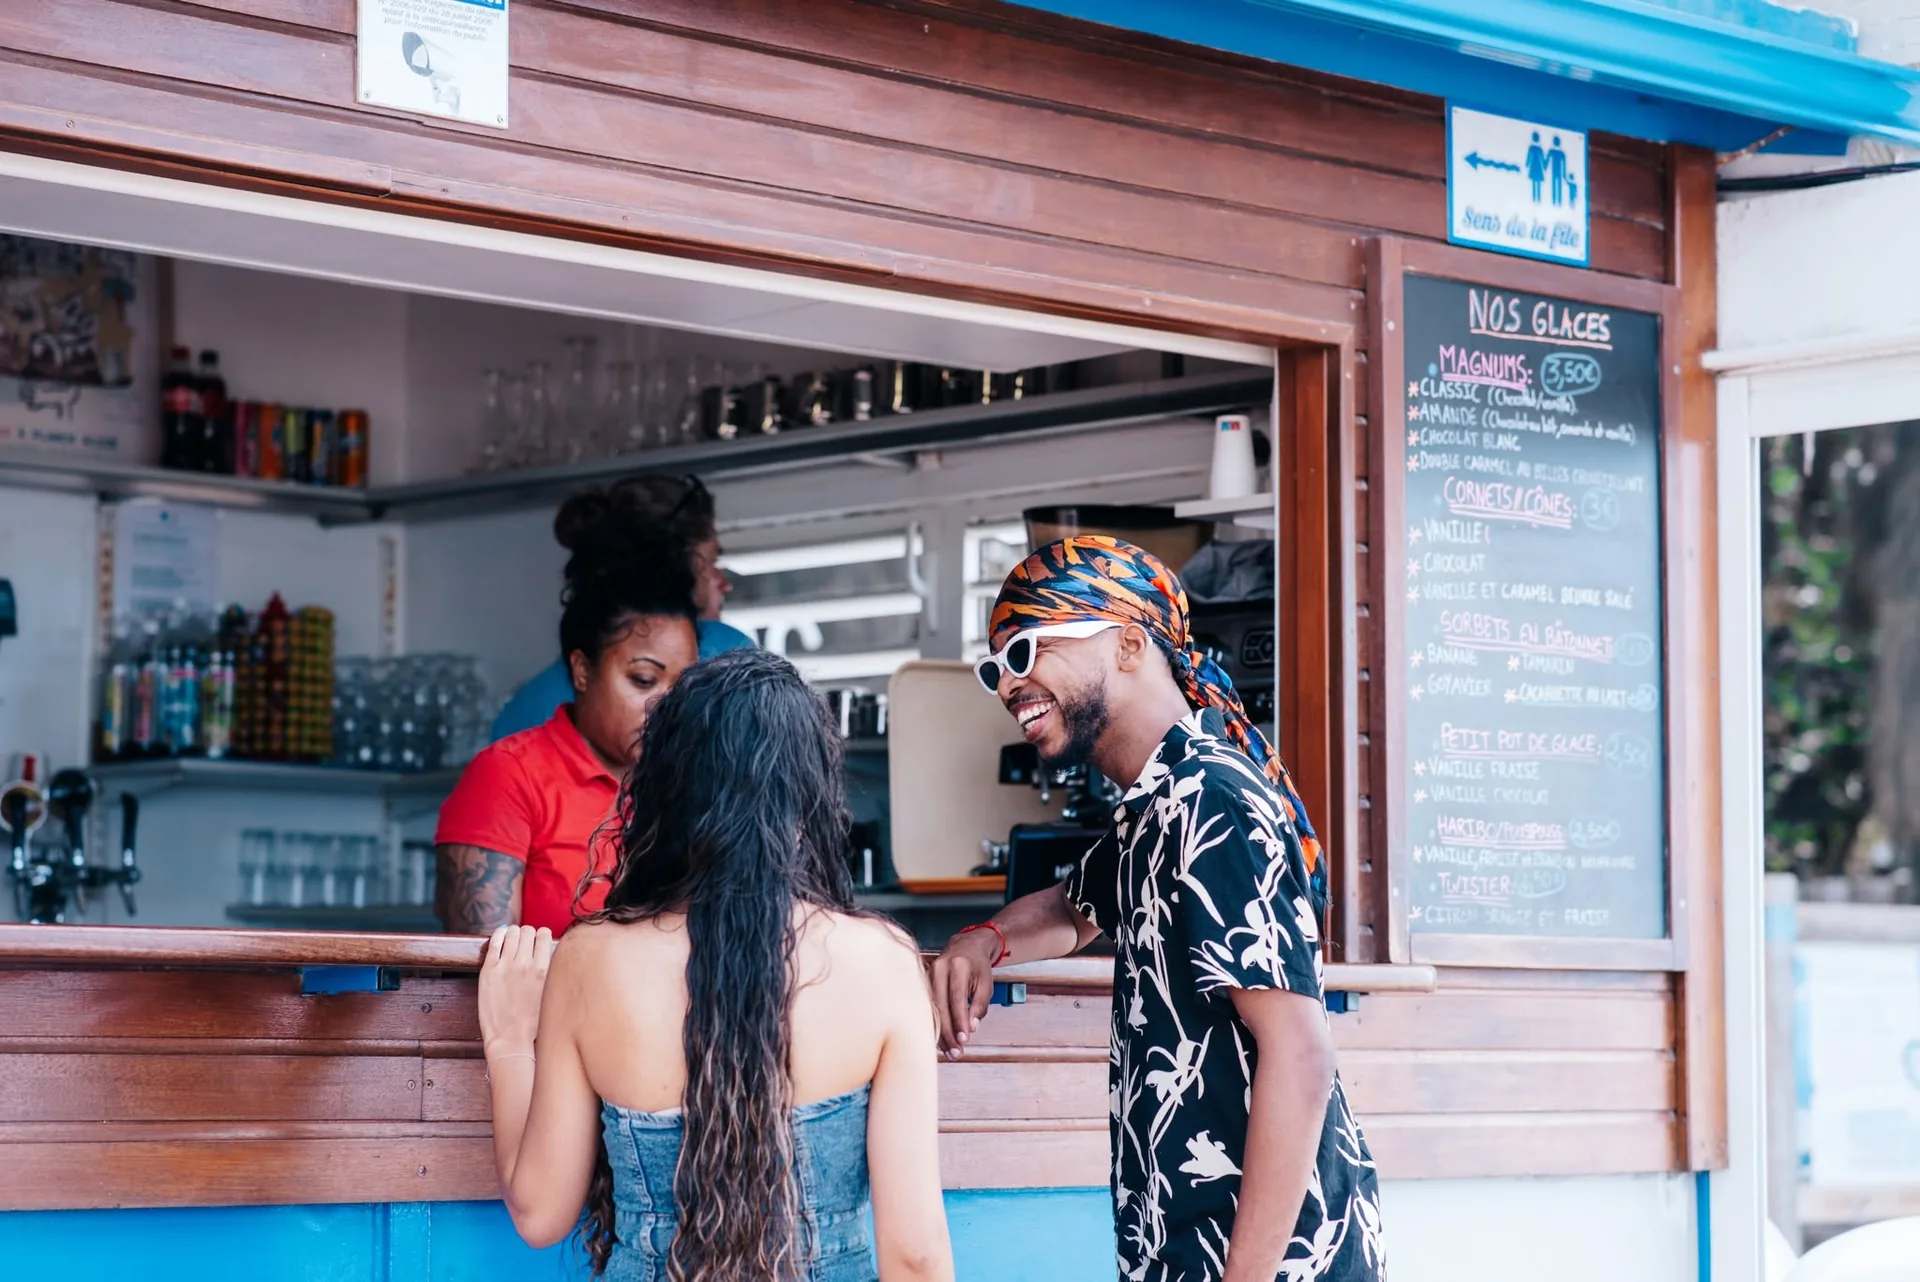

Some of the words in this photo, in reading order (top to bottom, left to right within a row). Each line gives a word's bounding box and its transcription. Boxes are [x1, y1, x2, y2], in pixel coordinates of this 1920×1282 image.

[1463, 206, 1501, 233] Sens
[1506, 214, 1527, 239] de
[1530, 218, 1547, 242] la
[1549, 221, 1580, 250] file
[1469, 288, 1521, 332] NOS
[1532, 302, 1611, 342] GLACES
[1439, 344, 1533, 385] MAGNUMS:
[1419, 377, 1482, 403] CLASSIC
[1419, 403, 1477, 425] AMANDE
[1419, 427, 1477, 448] CHOCOLAT
[1483, 433, 1521, 451] BLANC
[1420, 452, 1461, 471] DOUBLE
[1463, 455, 1513, 476] CARAMEL
[1423, 552, 1487, 574] CHOCOLAT
[1421, 581, 1477, 601] VANILLE
[1480, 582, 1496, 600] ET
[1501, 583, 1555, 604] CARAMEL
[1439, 609, 1510, 640] SORBETS
[1520, 621, 1538, 645] EN
[1427, 643, 1478, 666] BANANE
[1427, 672, 1493, 696] GOYAVIER
[1440, 721, 1489, 750] PETIT
[1497, 729, 1524, 750] POT
[1528, 732, 1546, 752] DE
[1428, 755, 1486, 780] VANILLE
[1490, 760, 1542, 781] FRAISE
[1429, 782, 1487, 804] VANILLE
[1493, 786, 1550, 806] CHOCOLAT
[1424, 903, 1479, 925] CITRON
[1538, 909, 1557, 929] ET
